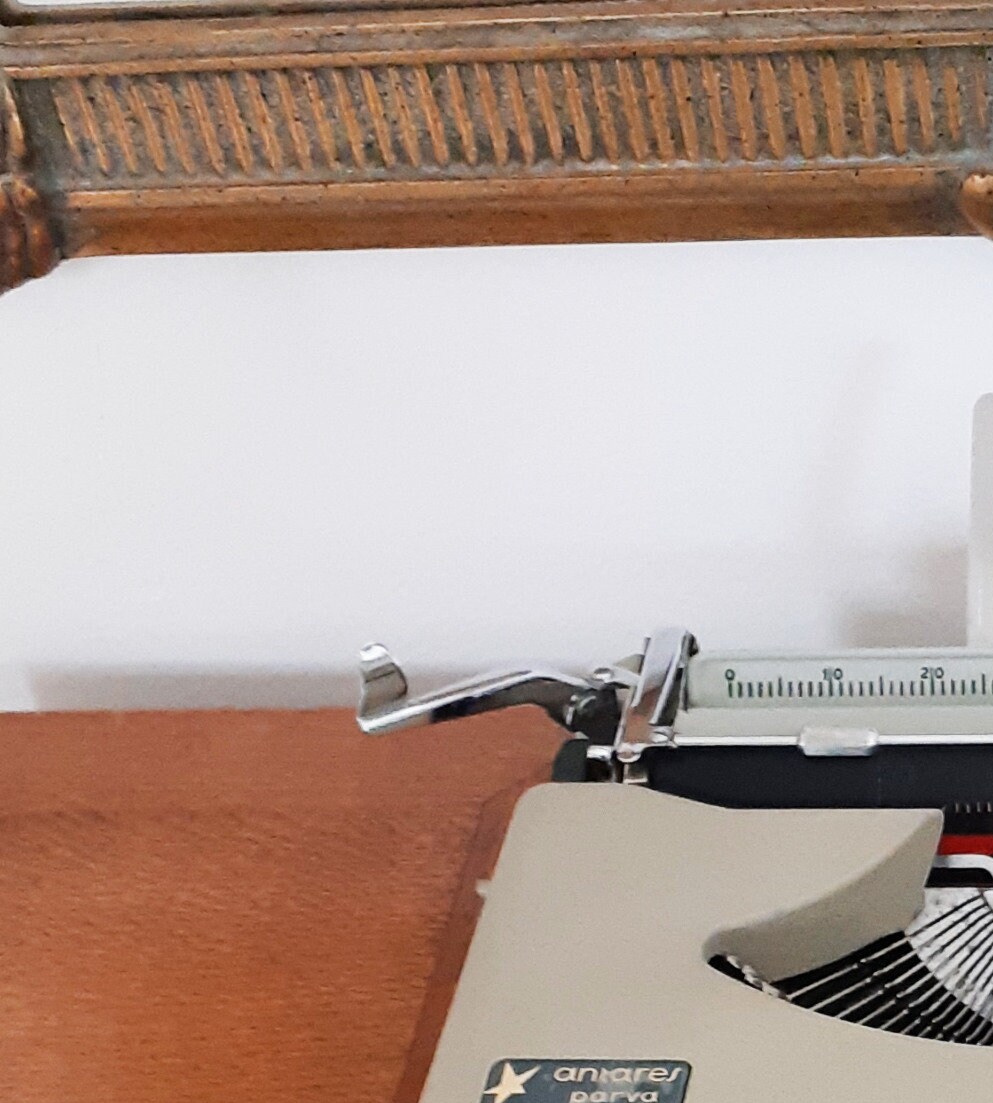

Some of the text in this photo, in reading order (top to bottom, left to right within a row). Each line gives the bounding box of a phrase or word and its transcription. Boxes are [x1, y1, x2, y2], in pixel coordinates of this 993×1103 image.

[725, 668, 736, 681] 0
[822, 667, 844, 681] 10
[920, 666, 945, 680] 20
